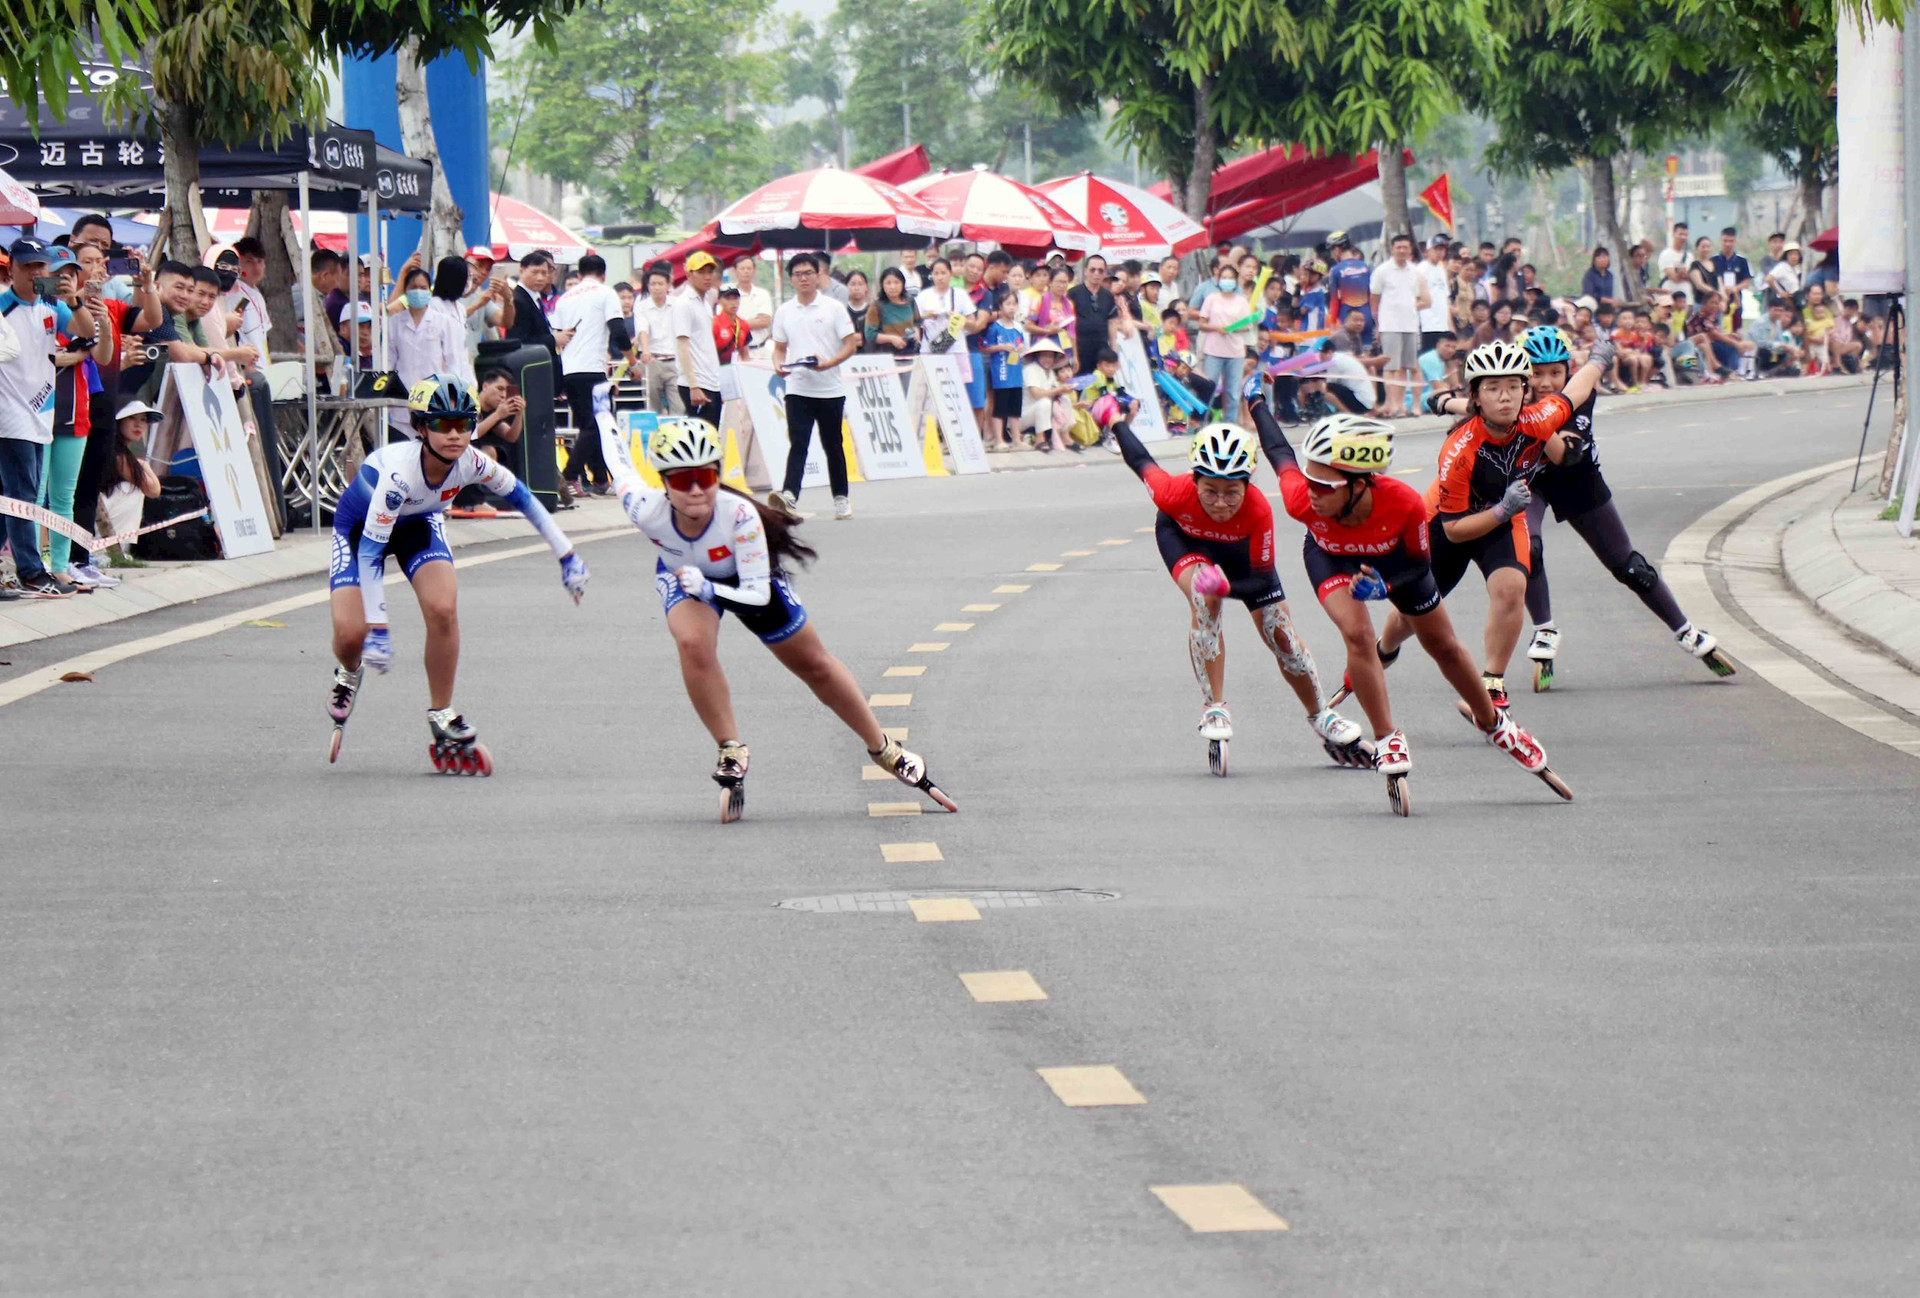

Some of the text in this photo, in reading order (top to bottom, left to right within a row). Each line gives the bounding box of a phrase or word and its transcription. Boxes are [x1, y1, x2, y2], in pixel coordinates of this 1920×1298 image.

[40, 141, 166, 166] 迈古轮
[863, 410, 903, 453] PLUS
[1340, 447, 1385, 463] 020
